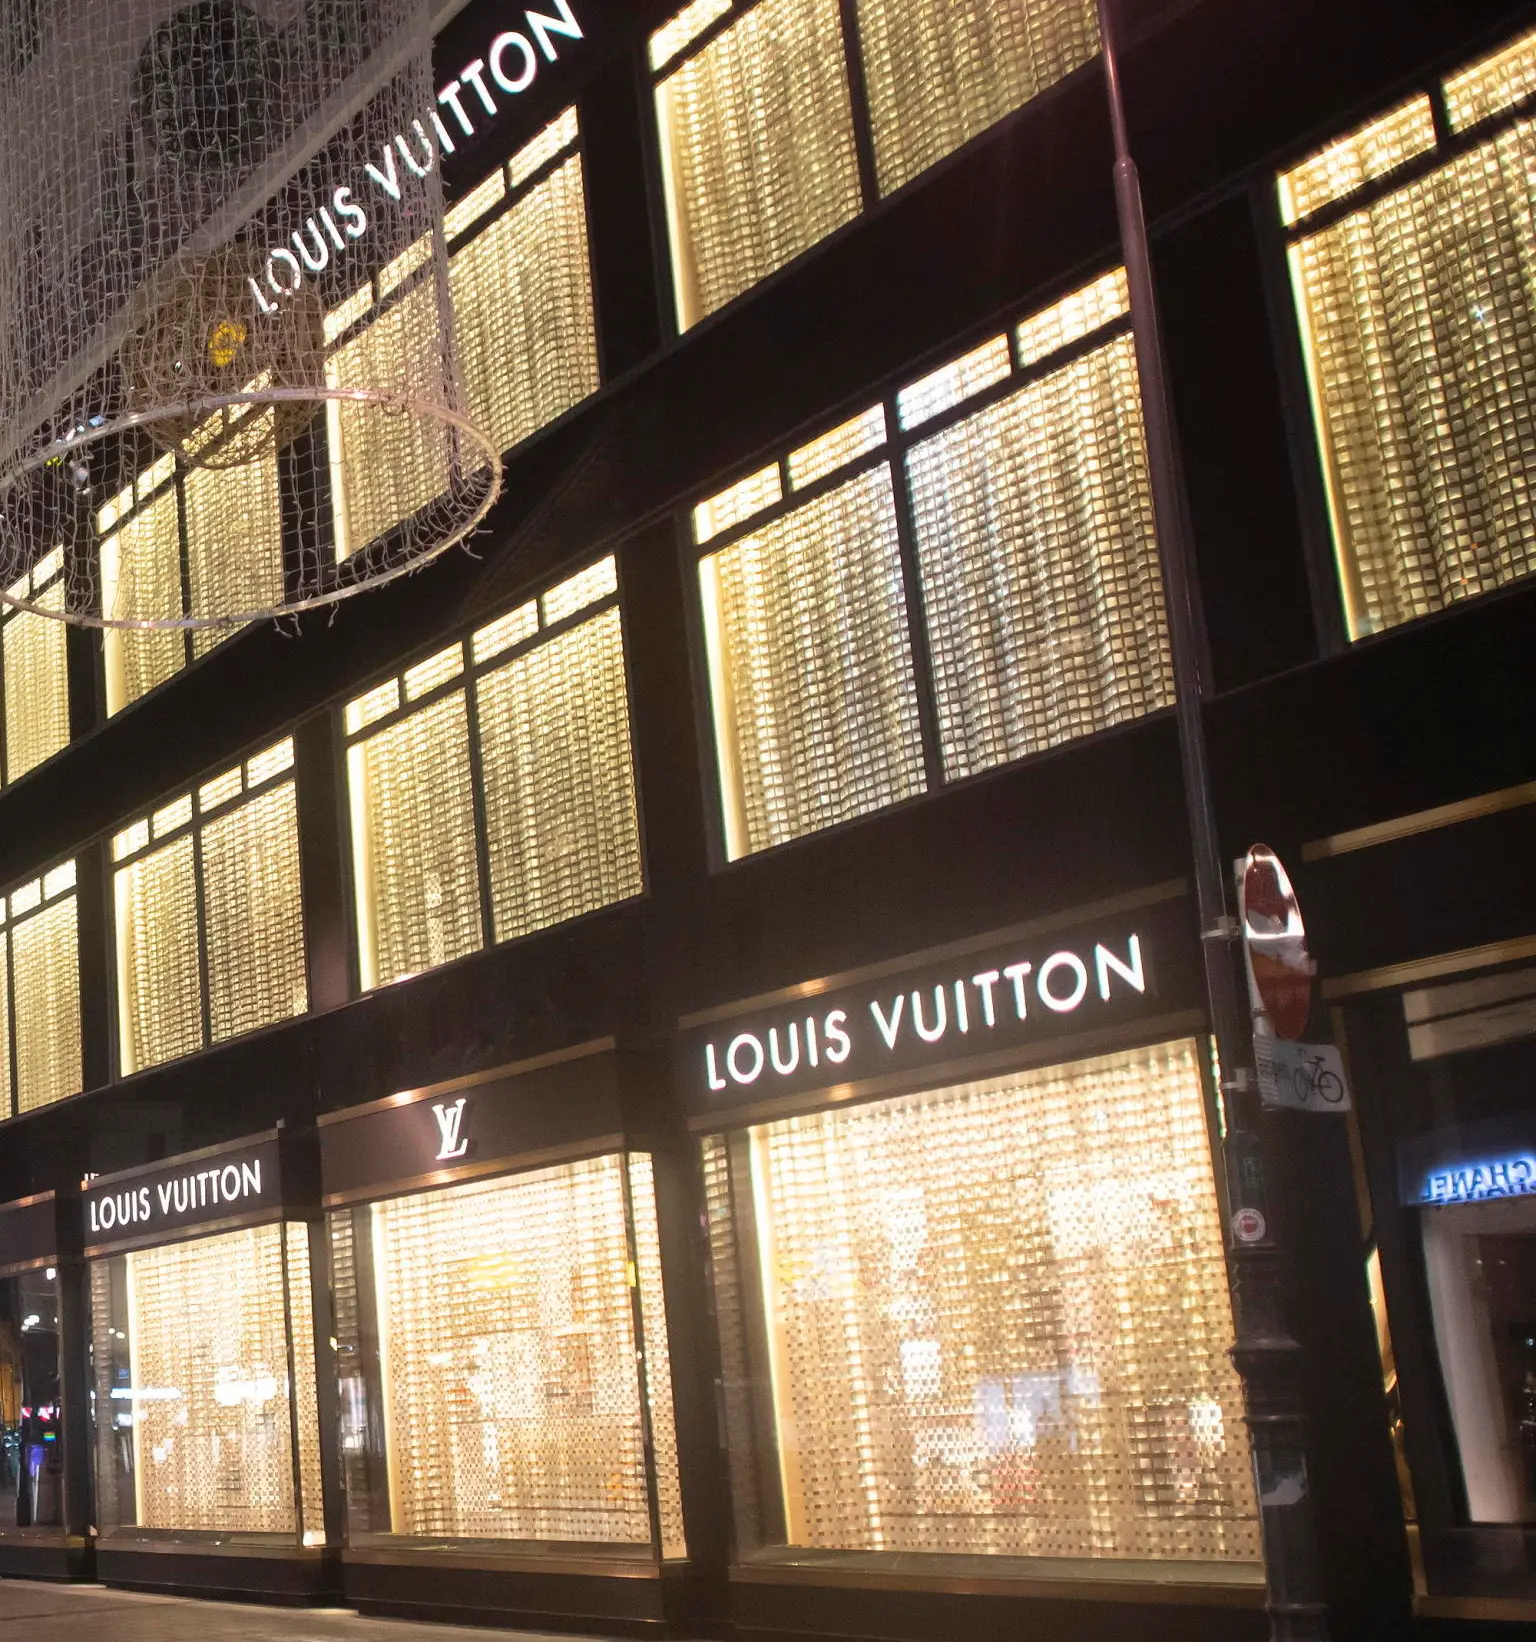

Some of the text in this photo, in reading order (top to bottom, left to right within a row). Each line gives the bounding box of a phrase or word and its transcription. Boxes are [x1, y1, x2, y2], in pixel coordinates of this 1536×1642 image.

[246, 0, 585, 316] LOUIS VUITTON
[705, 931, 1146, 1092] LOUIS VUITTON
[431, 1098, 469, 1161] LV
[89, 1158, 263, 1233] LOUIS VUITTON
